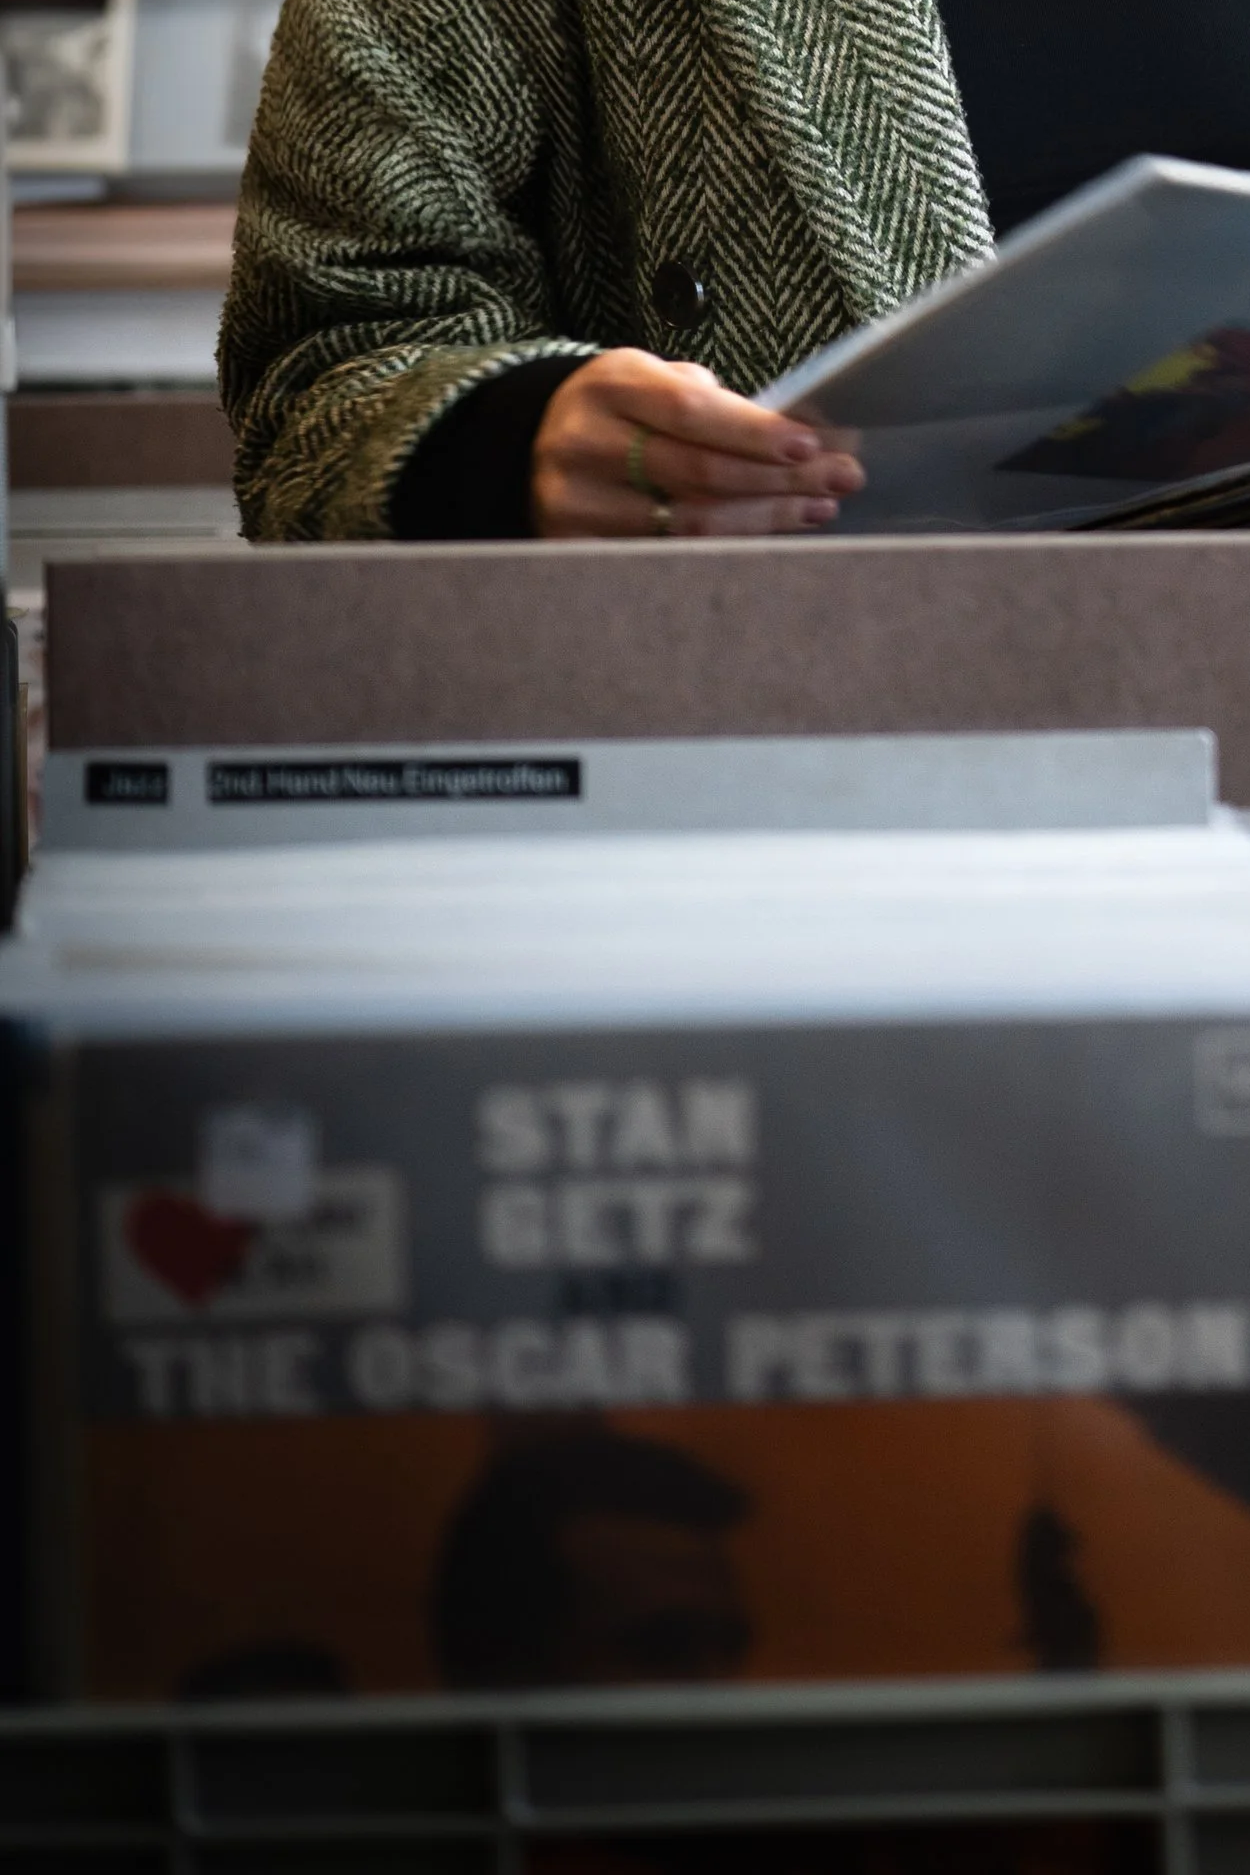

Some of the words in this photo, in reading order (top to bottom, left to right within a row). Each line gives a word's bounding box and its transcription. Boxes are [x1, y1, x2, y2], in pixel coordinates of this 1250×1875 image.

[403, 760, 567, 798] Eingetroffen
[481, 1083, 756, 1169] STAN
[483, 1180, 756, 1265] GETZ
[124, 1333, 318, 1415] THE
[347, 1322, 688, 1407] OSCAR
[731, 1305, 1250, 1397] PETERSON
